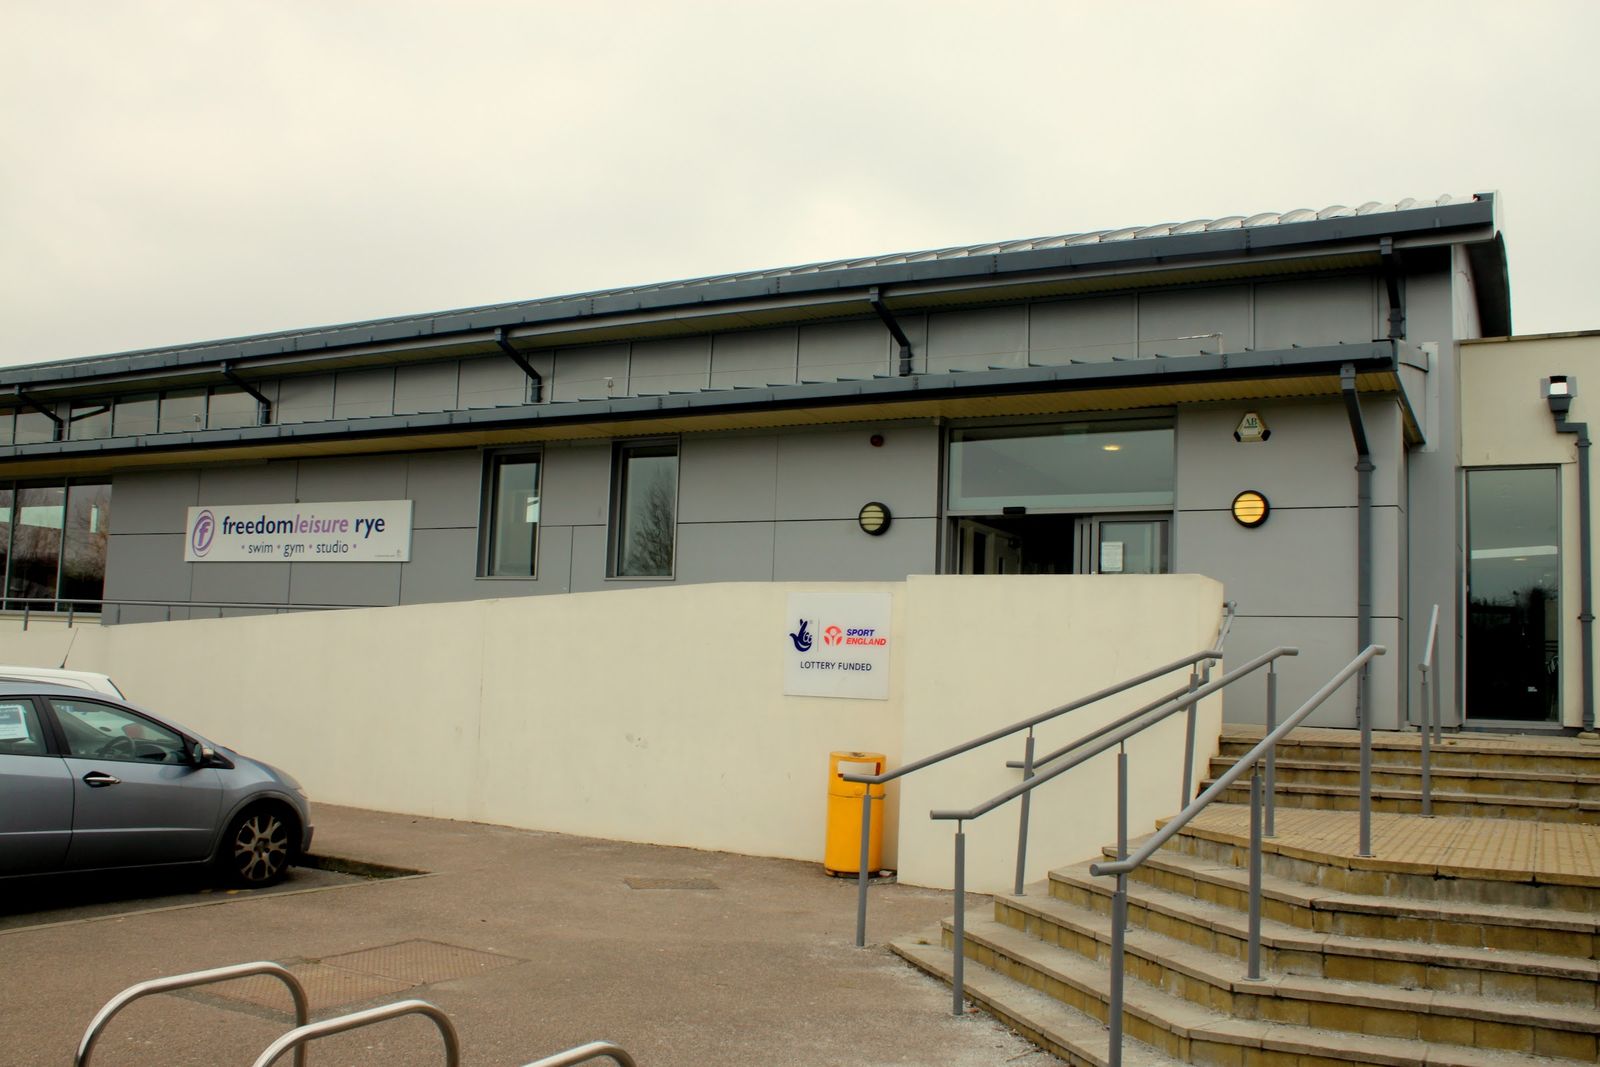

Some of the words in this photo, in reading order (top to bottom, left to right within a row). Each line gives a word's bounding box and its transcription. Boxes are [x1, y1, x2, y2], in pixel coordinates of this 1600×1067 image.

[222, 513, 349, 535] freedomleisure
[355, 517, 386, 539] rye
[248, 541, 273, 554] swim
[283, 543, 305, 558] gym
[316, 540, 349, 554] studio
[846, 628, 875, 637] SPORT
[845, 637, 887, 646] ENGLAND
[800, 661, 836, 670] LOTTERY
[838, 662, 872, 671] FUNDED
